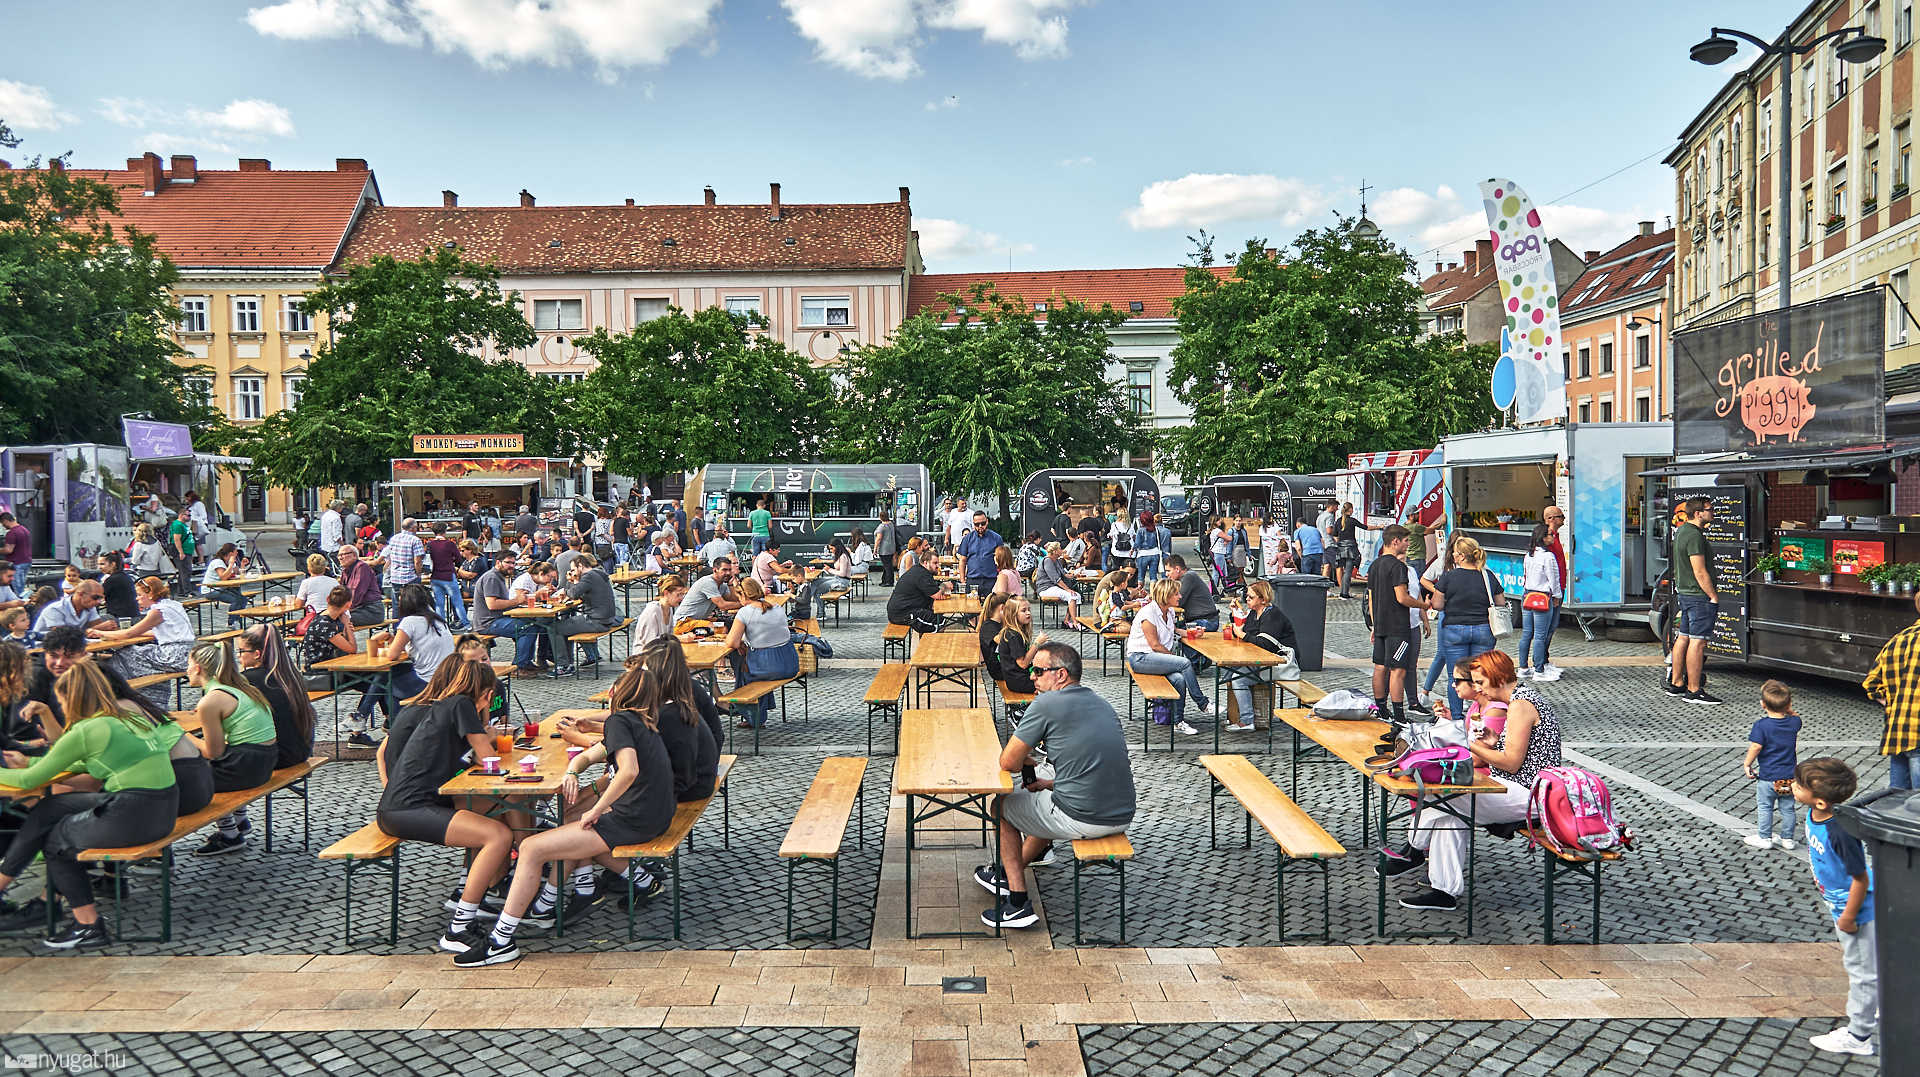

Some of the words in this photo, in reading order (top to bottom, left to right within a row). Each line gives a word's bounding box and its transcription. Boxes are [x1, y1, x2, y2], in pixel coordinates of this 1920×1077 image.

[1760, 319, 1777, 338] the
[1715, 320, 1824, 417] grilled
[420, 438, 454, 449] SMOKEY
[481, 437, 517, 448] MONKIES
